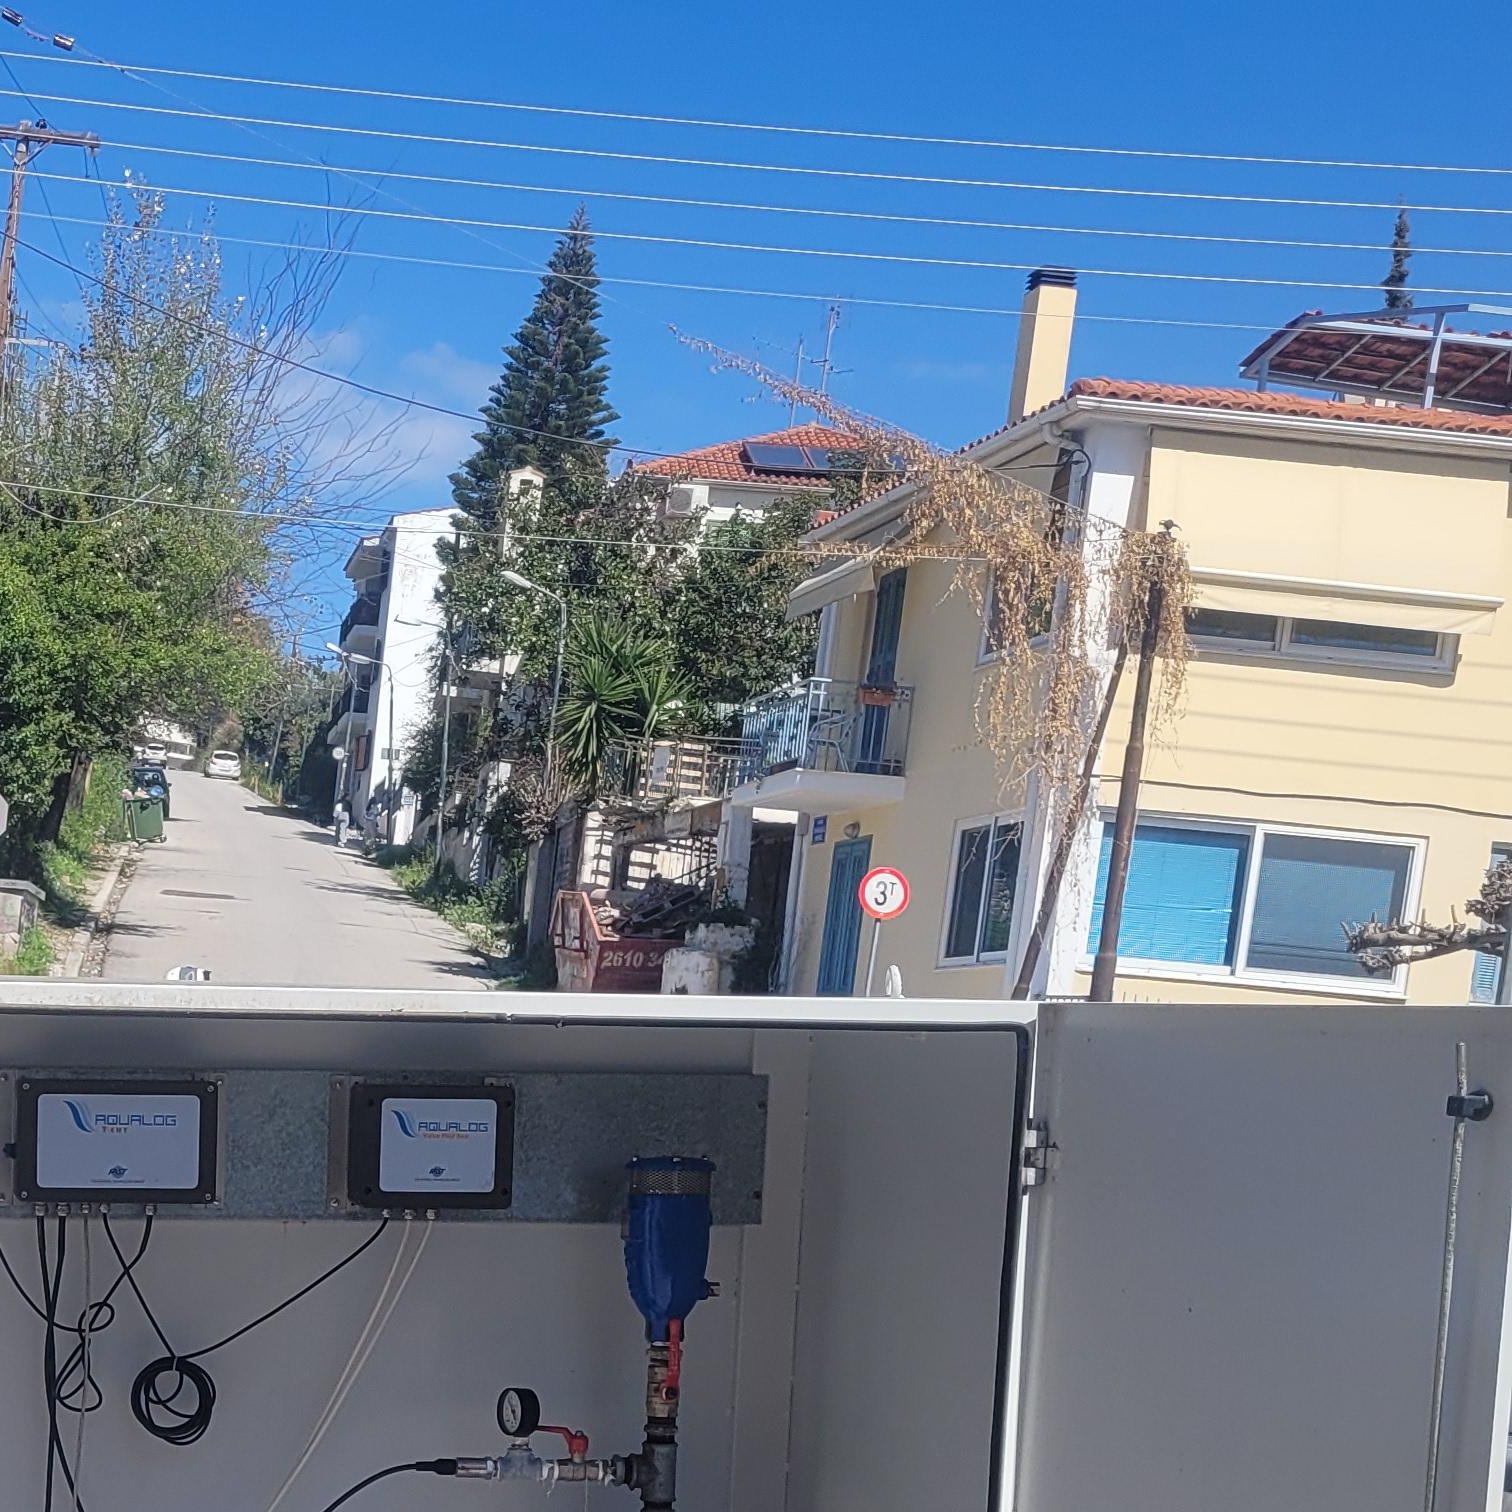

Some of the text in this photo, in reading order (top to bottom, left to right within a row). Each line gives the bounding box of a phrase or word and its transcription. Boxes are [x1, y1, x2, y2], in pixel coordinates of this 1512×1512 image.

[600, 949, 644, 970] 2610
[94, 1114, 177, 1127] AQUALOG
[417, 1121, 489, 1132] AQUALOG
